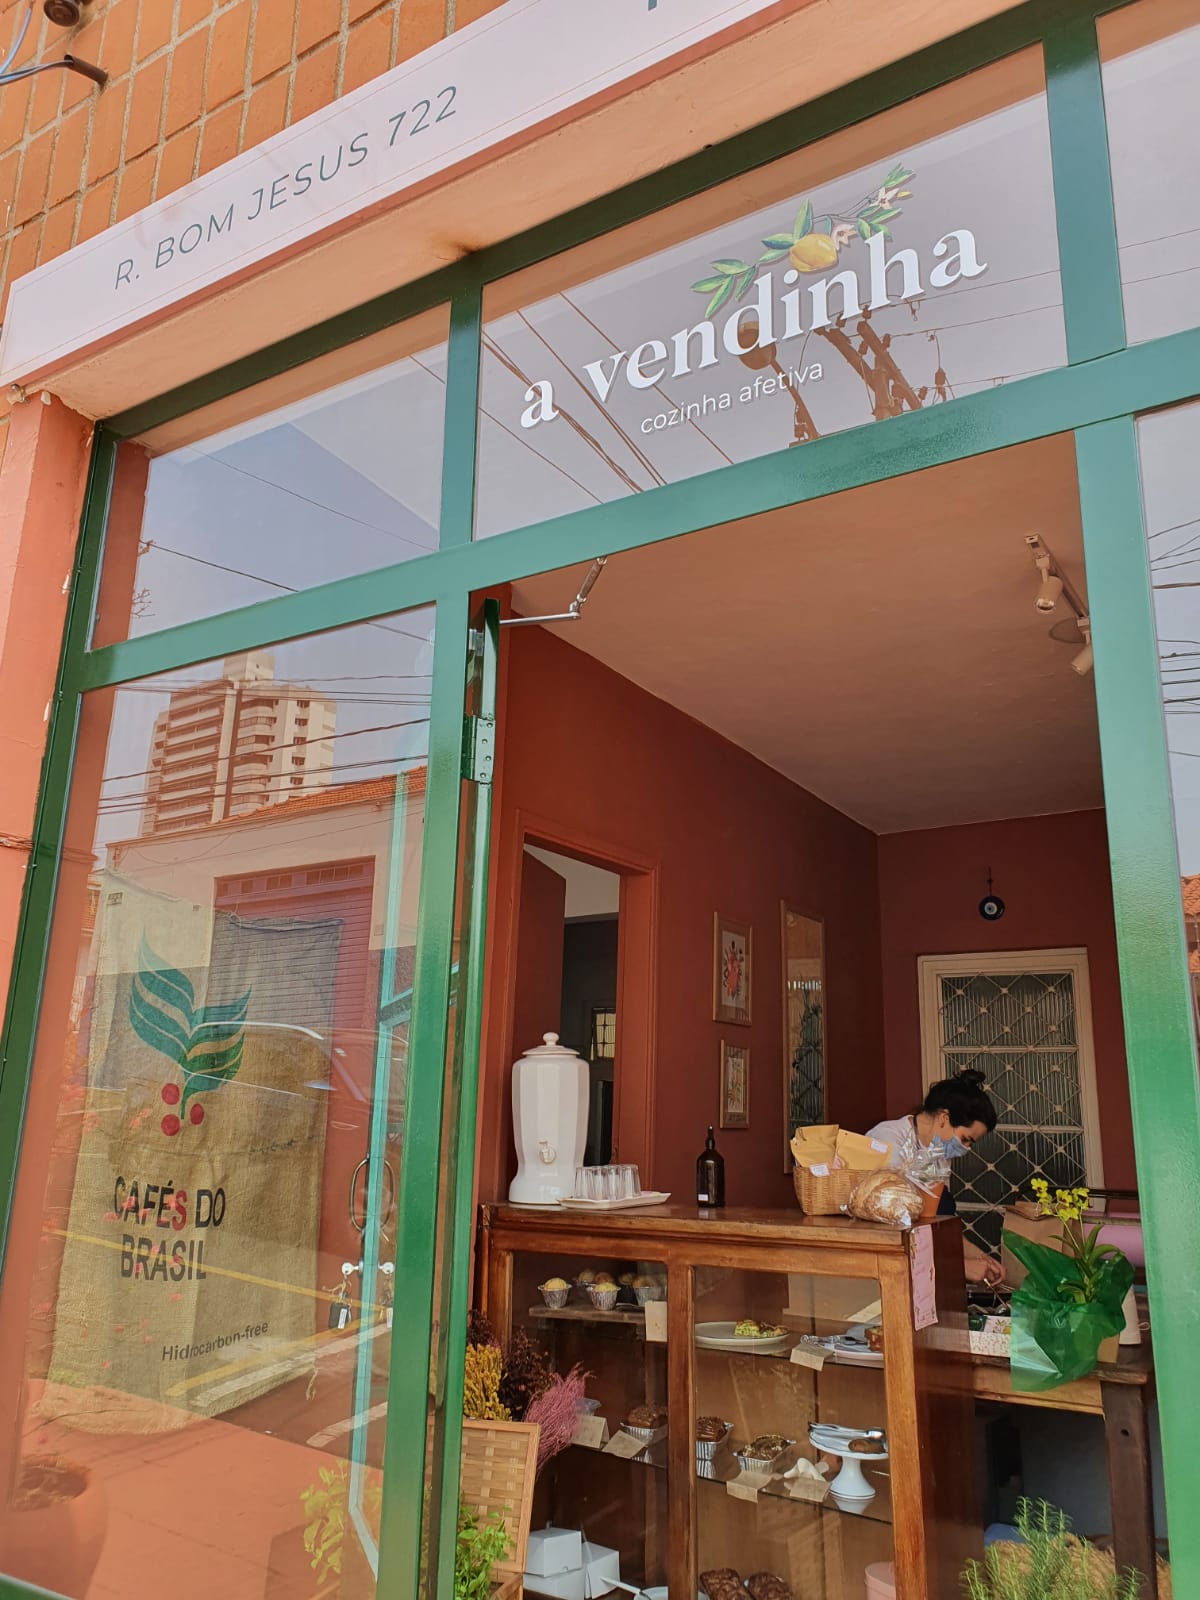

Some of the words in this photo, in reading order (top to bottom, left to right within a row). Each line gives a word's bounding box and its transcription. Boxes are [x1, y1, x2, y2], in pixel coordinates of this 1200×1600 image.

[115, 258, 139, 290] R.
[154, 203, 235, 269] BOM
[247, 132, 369, 221] JESUS
[388, 85, 457, 147] 722
[519, 380, 560, 430] a
[583, 228, 987, 403] vendinha
[640, 391, 732, 434] cozinha
[738, 362, 824, 403] afetiva
[113, 1175, 188, 1231] CAFÉS
[195, 1187, 226, 1229] DO
[120, 1233, 207, 1282] BRASIL
